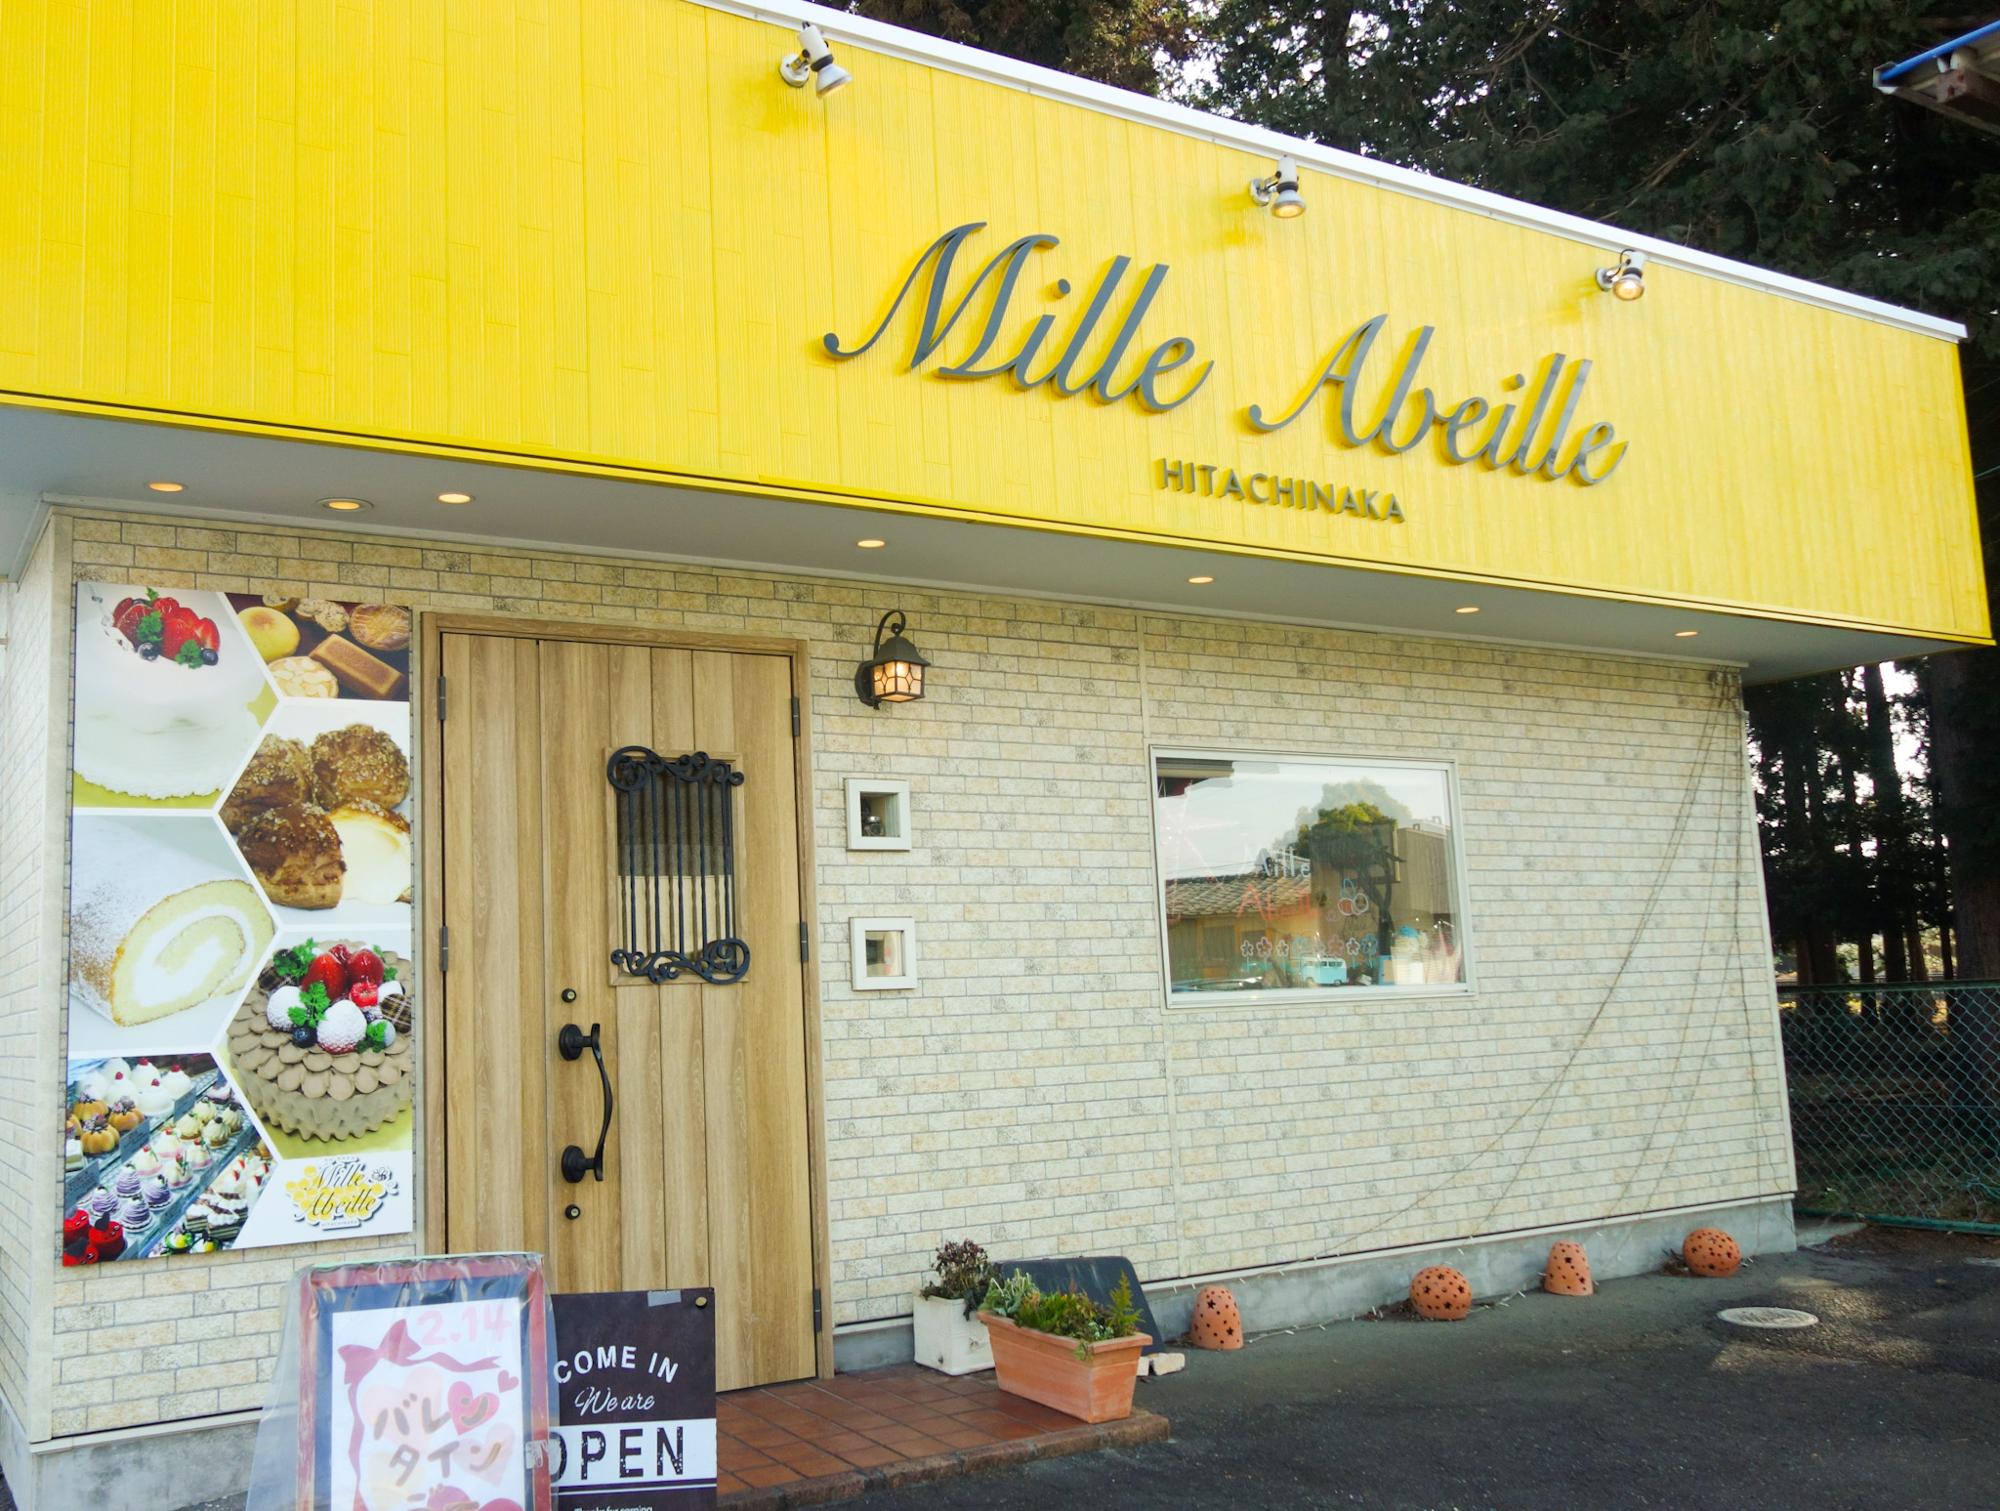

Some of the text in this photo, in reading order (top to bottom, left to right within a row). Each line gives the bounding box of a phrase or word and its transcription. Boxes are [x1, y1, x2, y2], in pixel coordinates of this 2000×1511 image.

[823, 221, 1630, 486] Mille Abeille
[1155, 457, 1405, 523] HITACHINAKA
[417, 1304, 512, 1345] 2.14
[553, 1345, 679, 1383] COME IN
[373, 1392, 489, 1441] バレン
[574, 1386, 656, 1417] We are
[388, 1440, 502, 1487] タイン
[549, 1426, 684, 1483] OPEN
